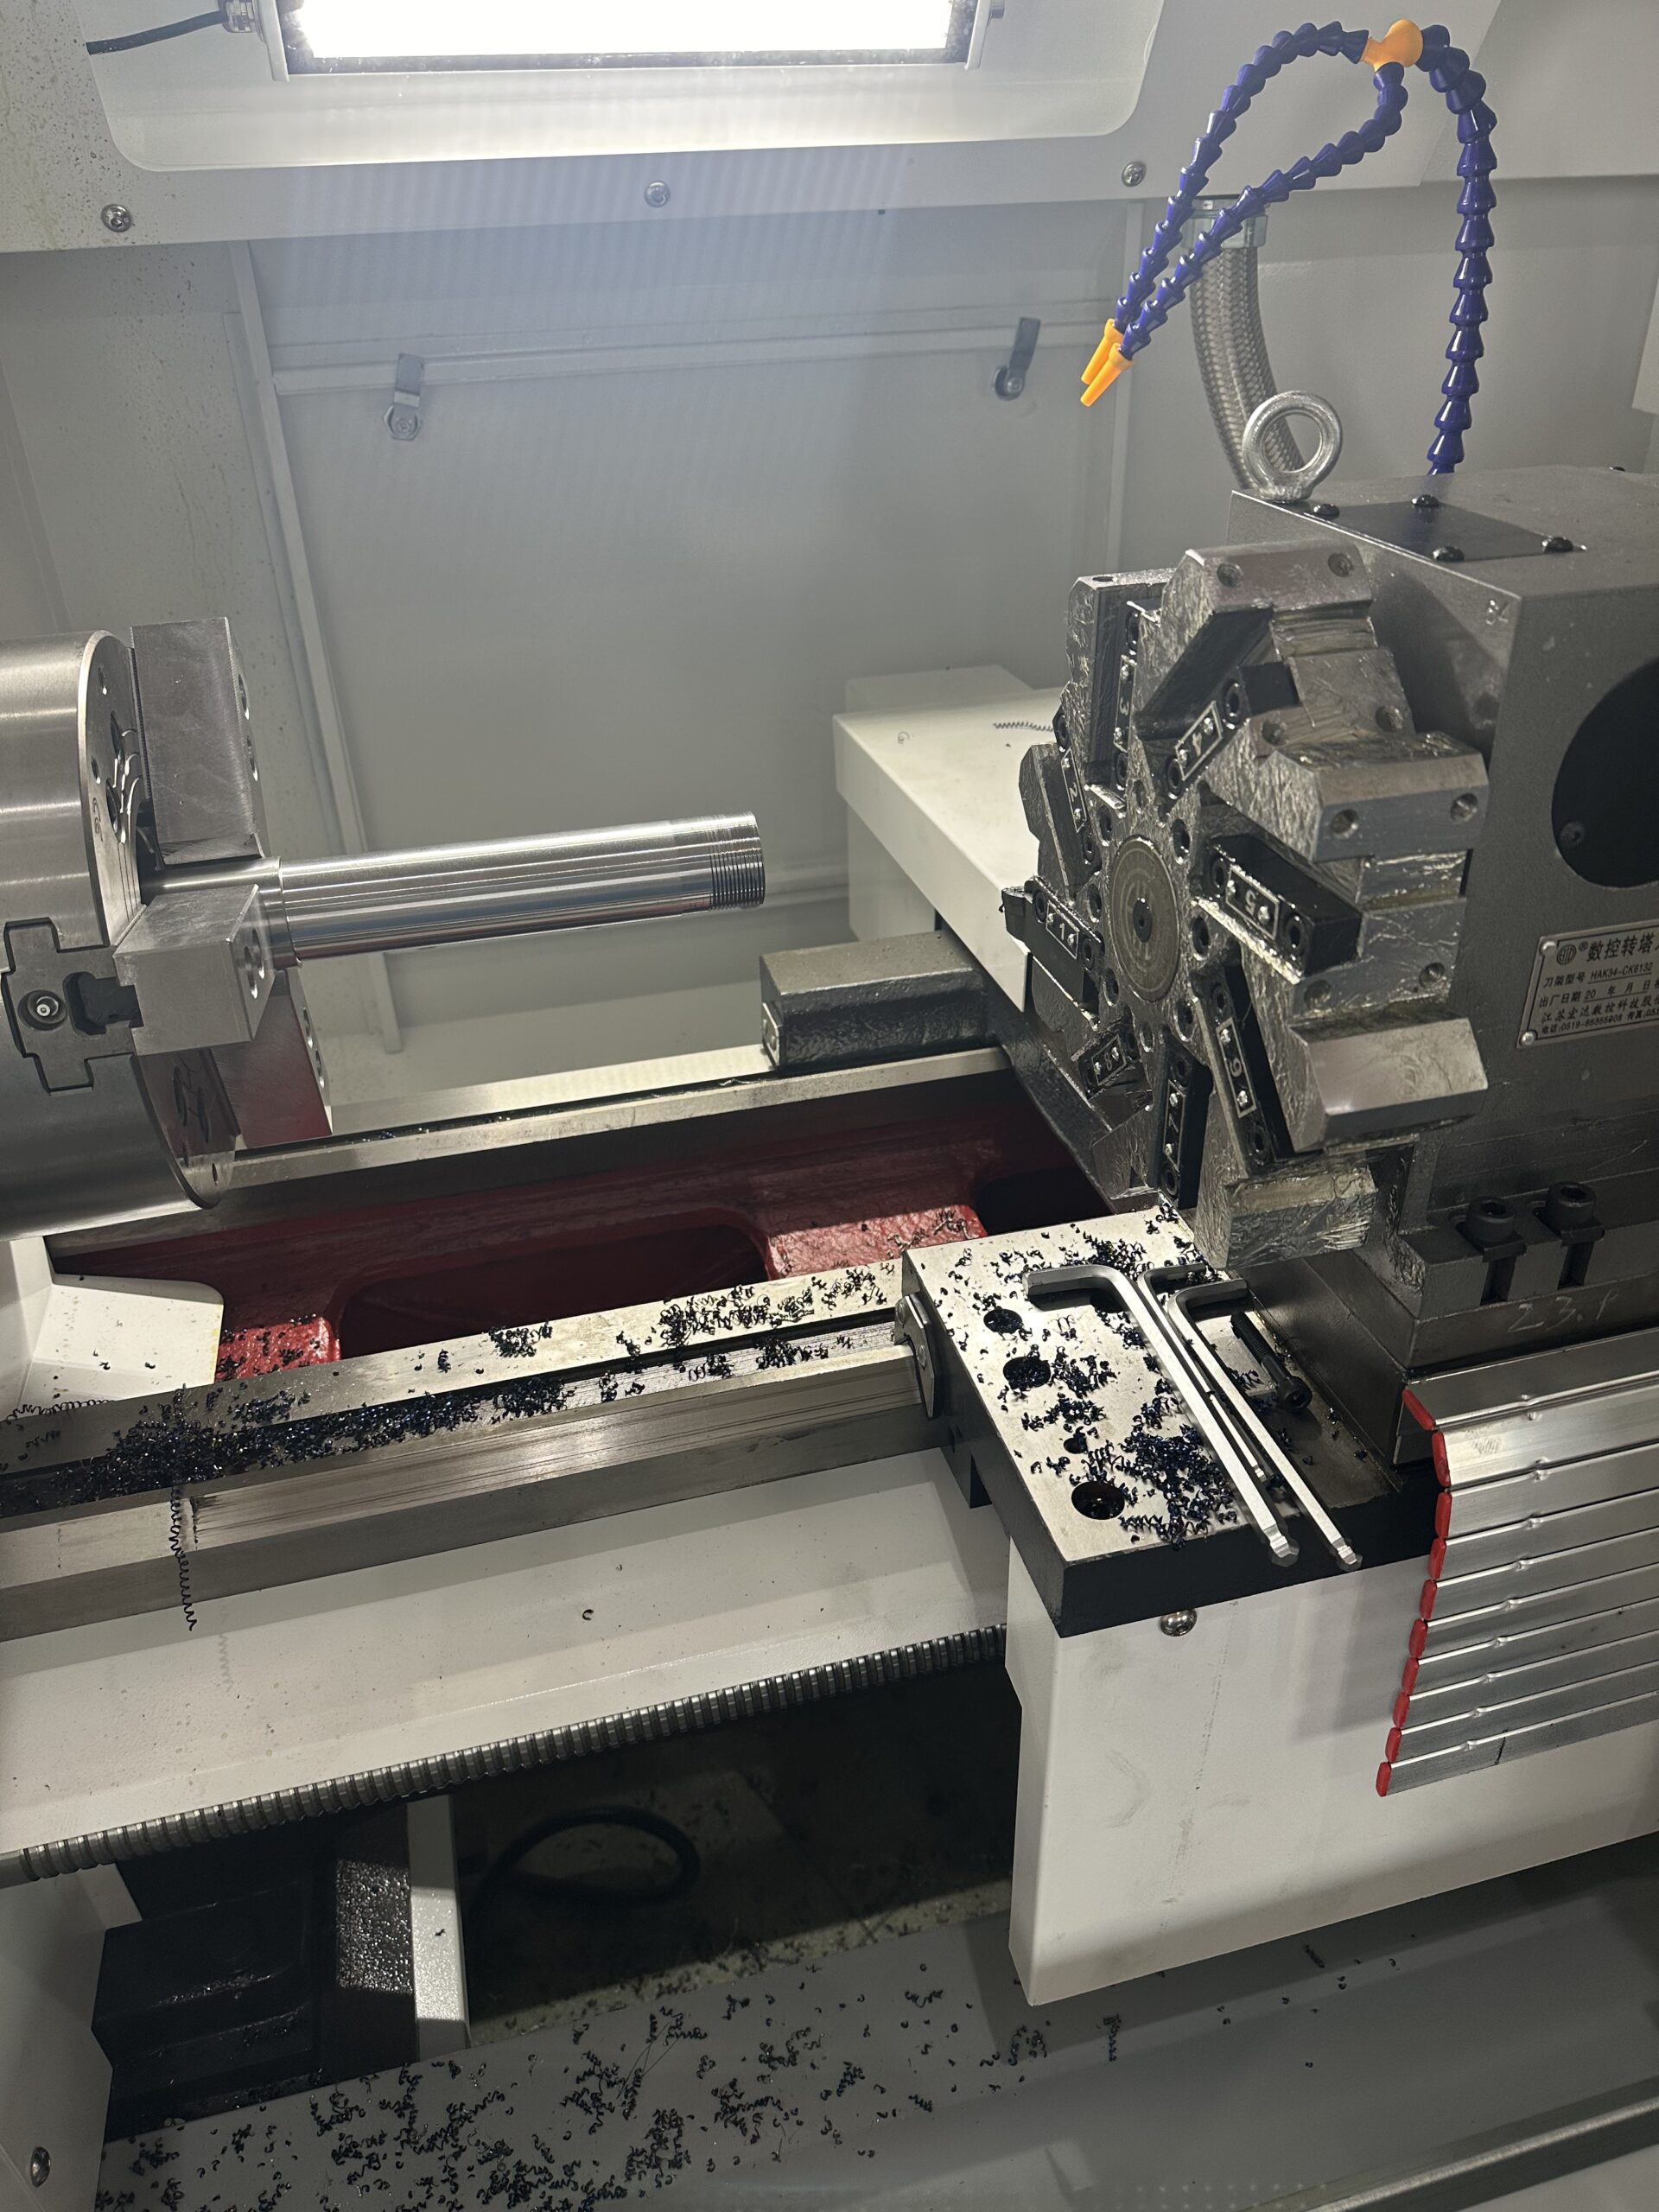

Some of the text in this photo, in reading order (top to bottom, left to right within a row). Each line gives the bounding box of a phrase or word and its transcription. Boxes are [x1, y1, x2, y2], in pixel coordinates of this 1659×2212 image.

[1119, 696, 1130, 716] 3
[1192, 732, 1203, 757] 4
[1068, 781, 1078, 803] 2
[1244, 889, 1257, 917] 5
[1058, 922, 1065, 941] 1
[1586, 932, 1659, 962] 数控转塔
[1543, 971, 1586, 988] 刀架型号
[1539, 991, 1581, 1007] 出厂日期
[1585, 989, 1597, 1000] 20
[1606, 985, 1617, 997] 年
[1624, 982, 1634, 995] 月
[1643, 979, 1651, 990] 日
[1103, 1051, 1113, 1071] 8
[1168, 1113, 1179, 1133] 7
